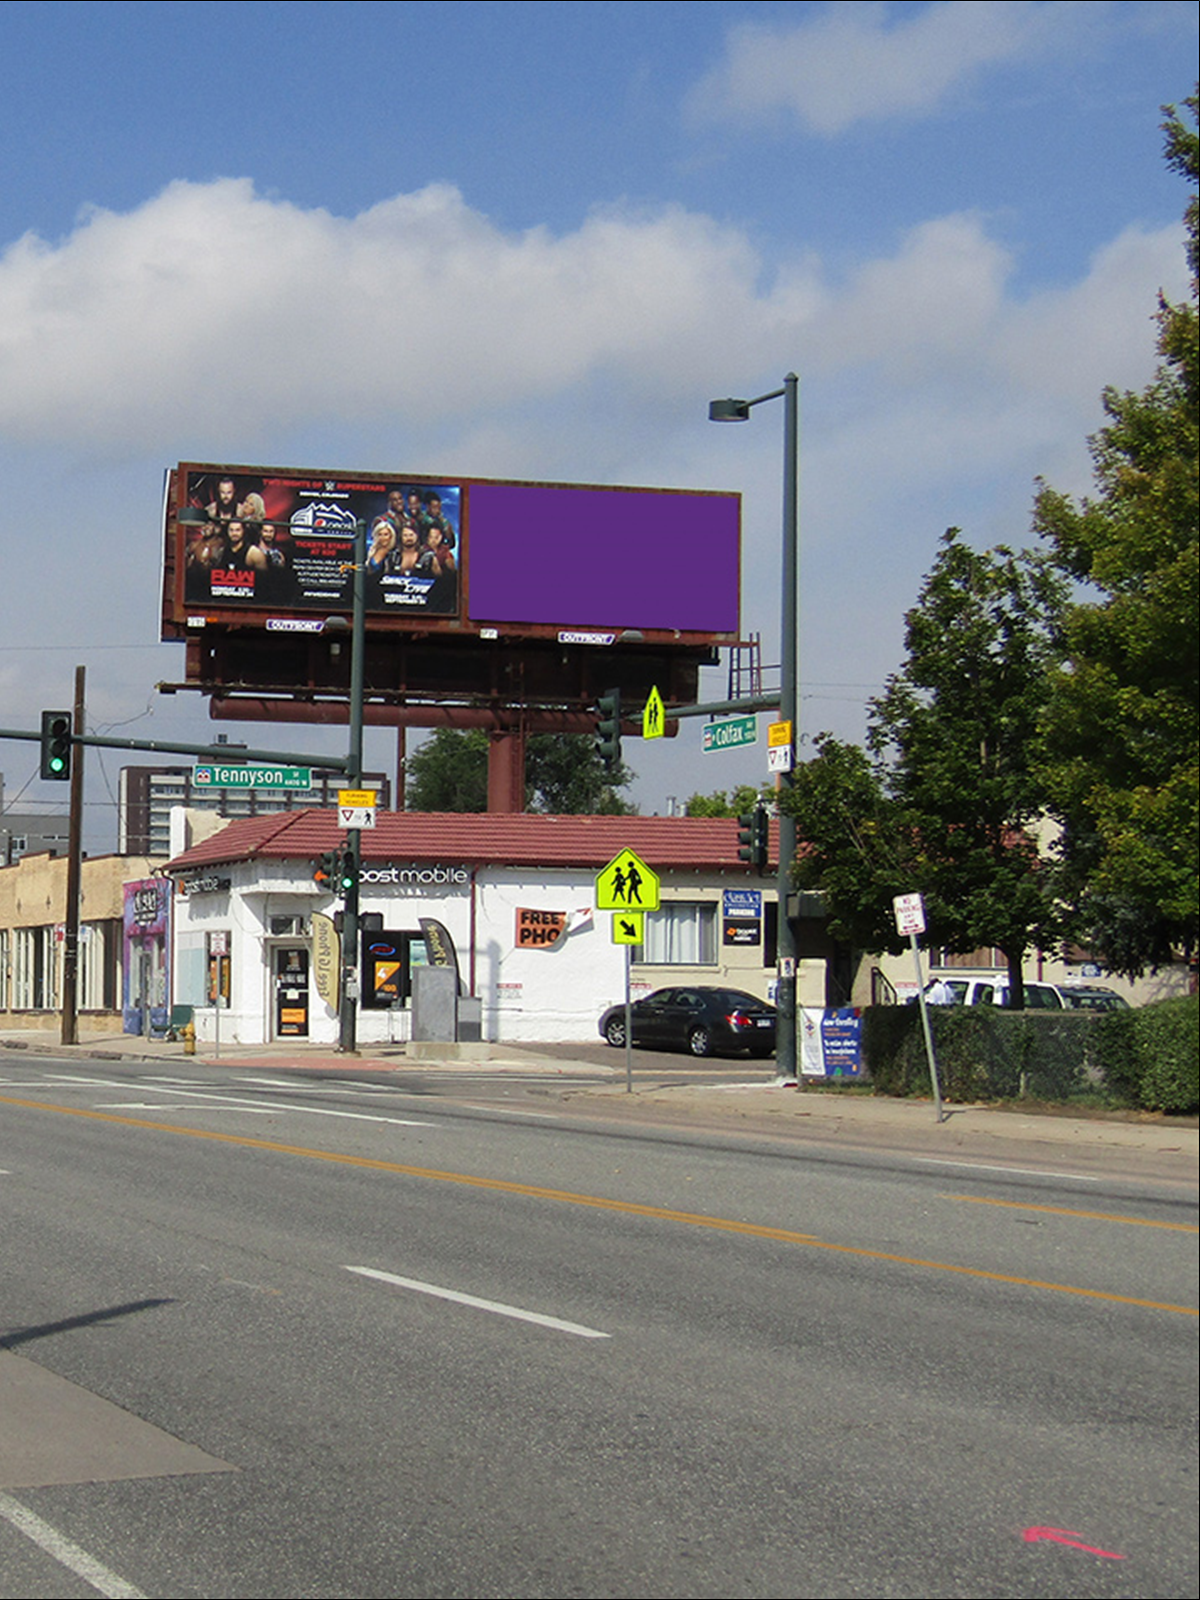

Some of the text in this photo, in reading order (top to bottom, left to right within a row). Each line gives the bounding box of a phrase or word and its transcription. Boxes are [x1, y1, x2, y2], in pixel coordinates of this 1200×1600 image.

[211, 569, 255, 583] RAW
[716, 724, 743, 746] Colfax
[213, 767, 283, 787] Tennyson
[520, 911, 560, 925] FREE
